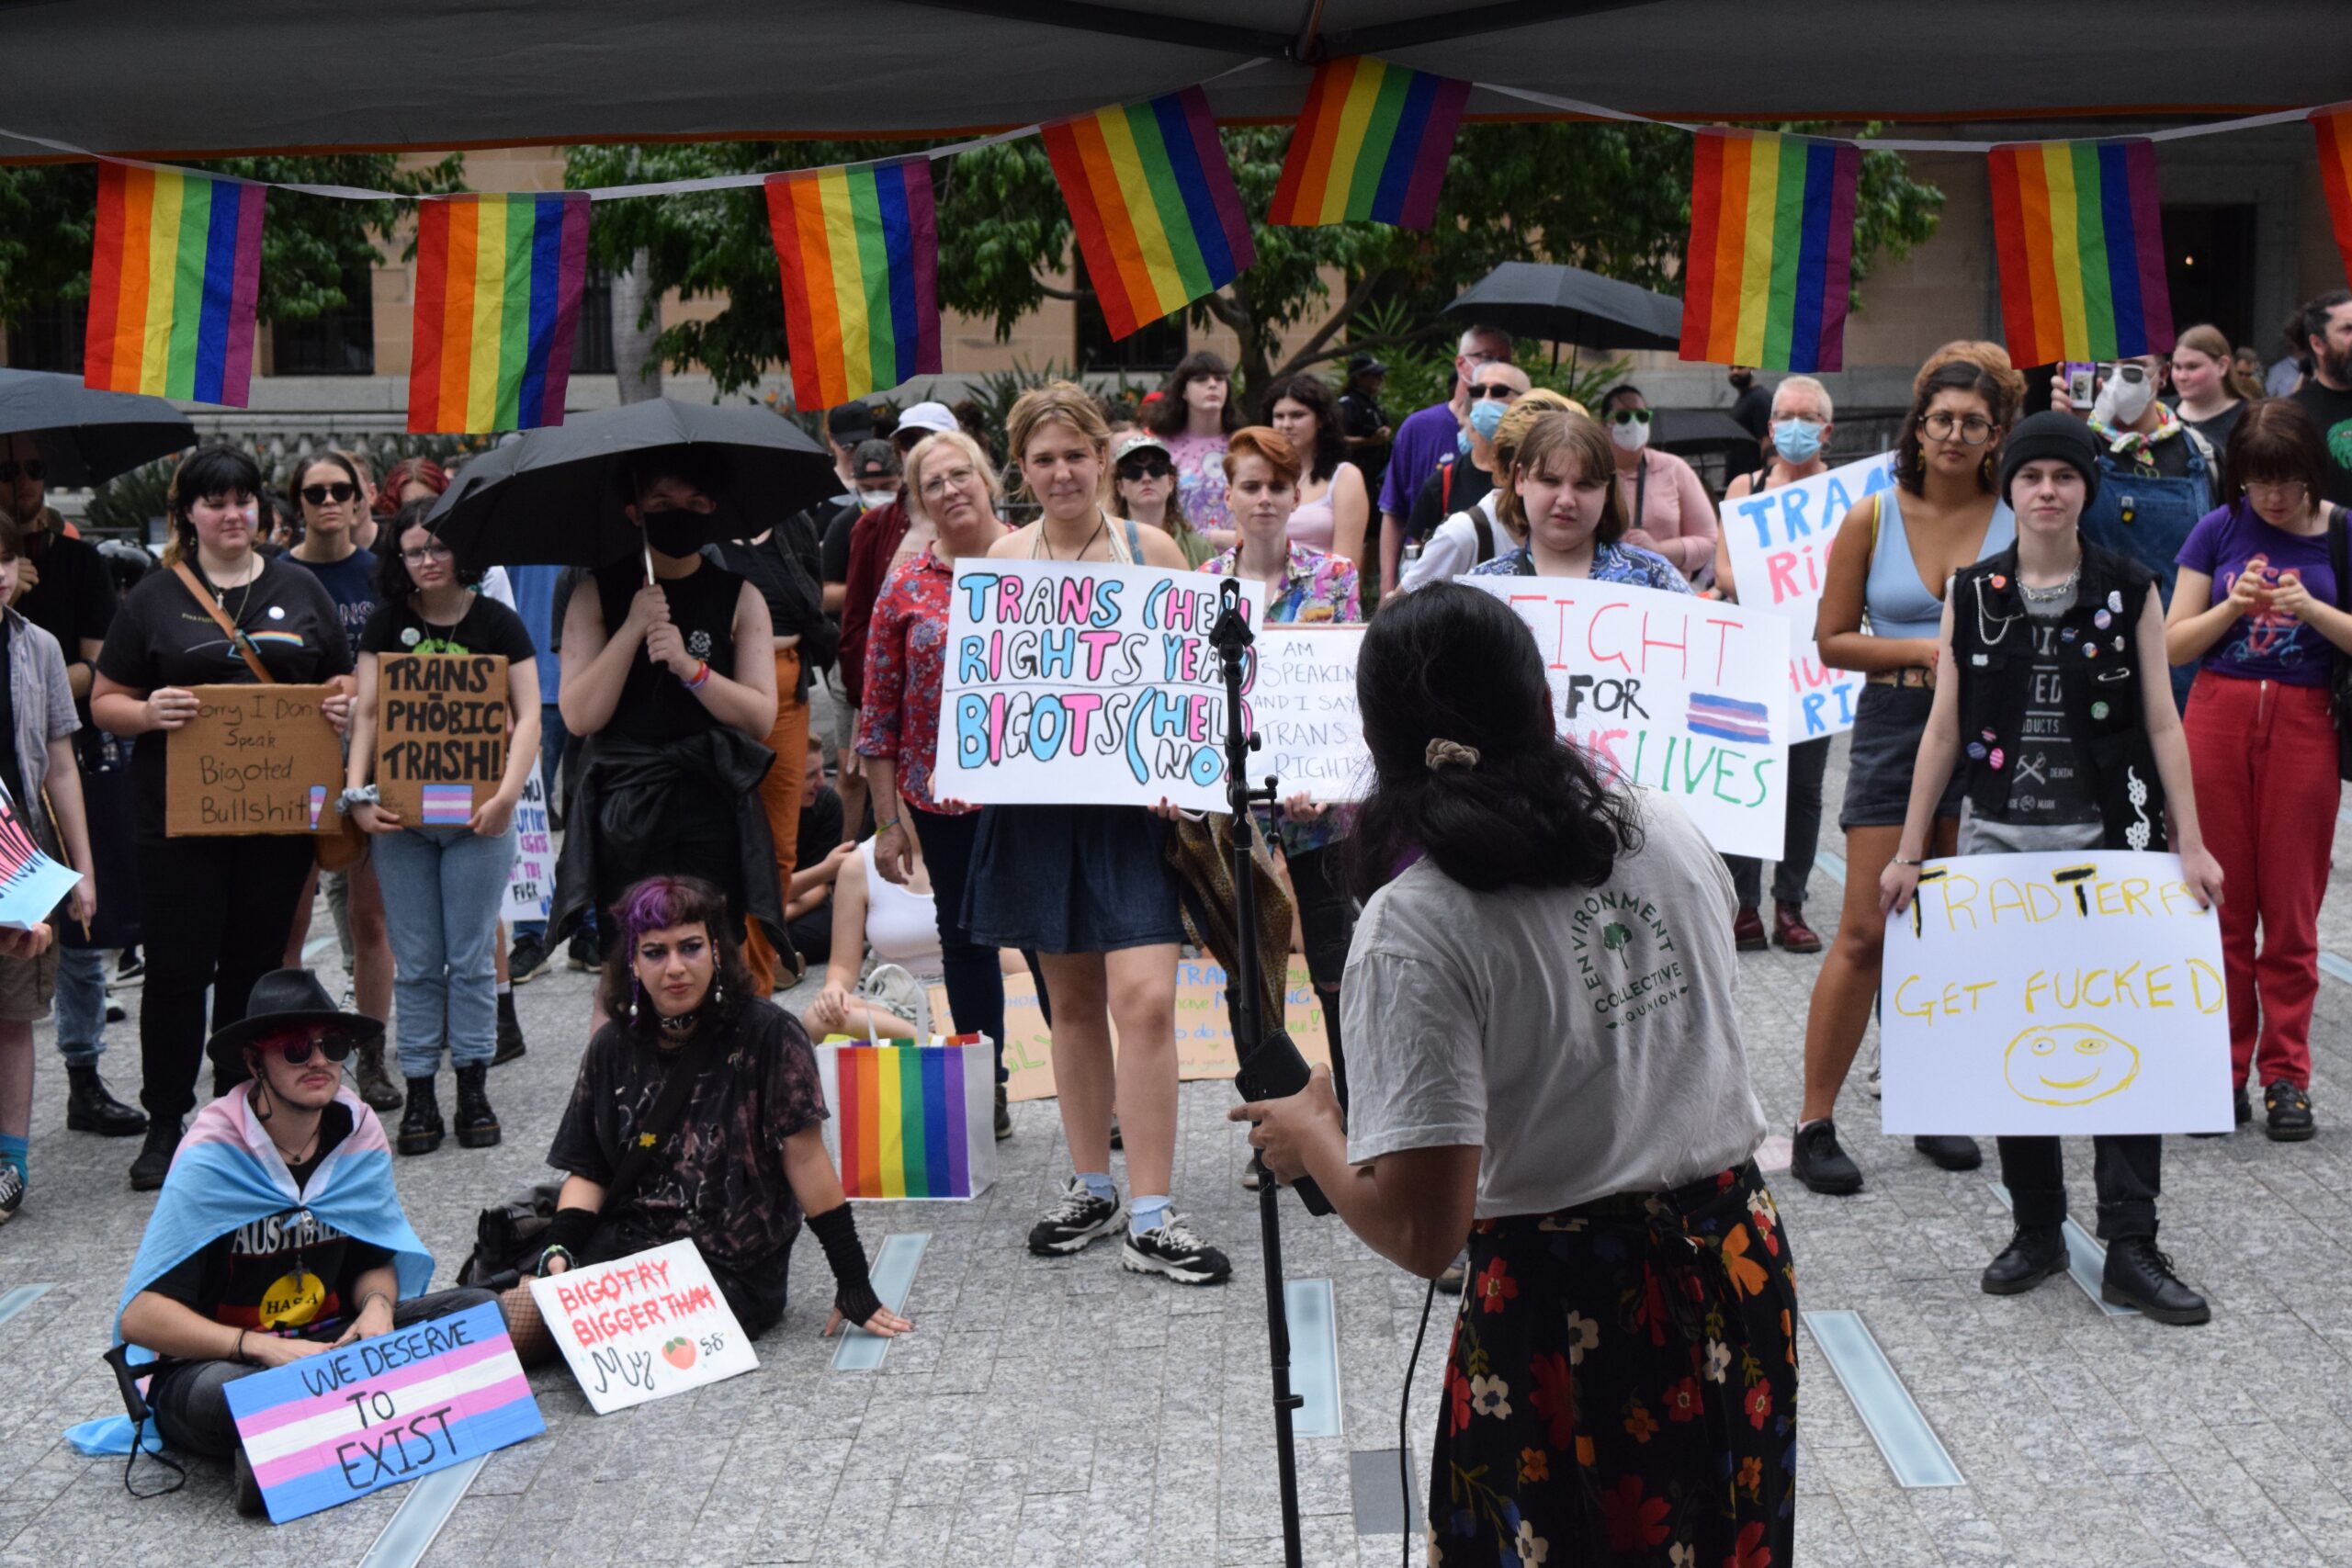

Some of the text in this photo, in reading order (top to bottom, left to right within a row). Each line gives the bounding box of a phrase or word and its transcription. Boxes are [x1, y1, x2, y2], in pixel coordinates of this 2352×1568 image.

[1738, 463, 1895, 548] TRA
[957, 572, 1124, 628] TRANS
[959, 628, 1257, 696] RIGHTS YEA)
[1283, 641, 1314, 657] AM
[385, 657, 495, 694] TRANS
[1261, 662, 1355, 687] SPEAKIN
[1565, 674, 1650, 719] FOR
[2030, 674, 2063, 704] ED
[198, 704, 243, 726] orry
[252, 694, 265, 718] I
[1255, 695, 1357, 714] AND I SAY
[224, 728, 277, 752] Speak
[956, 692, 1130, 769] BIGOTS
[1257, 719, 1348, 747] TRANS
[200, 755, 294, 792] Bigoted
[382, 739, 501, 781] TRASH!
[201, 784, 327, 830] Bullshit!
[1571, 891, 1675, 991] ENVIRONMENT
[1594, 962, 1682, 1014] COLLECTIVE
[1894, 974, 1997, 1027] GET
[2025, 958, 2225, 1014] FUCKED
[557, 1258, 669, 1316] BIGOTRY
[571, 1283, 718, 1348] BIGGER THAN
[301, 1320, 475, 1397] WE DESERVE
[345, 1391, 396, 1429] TO
[335, 1406, 458, 1491] EXIST
